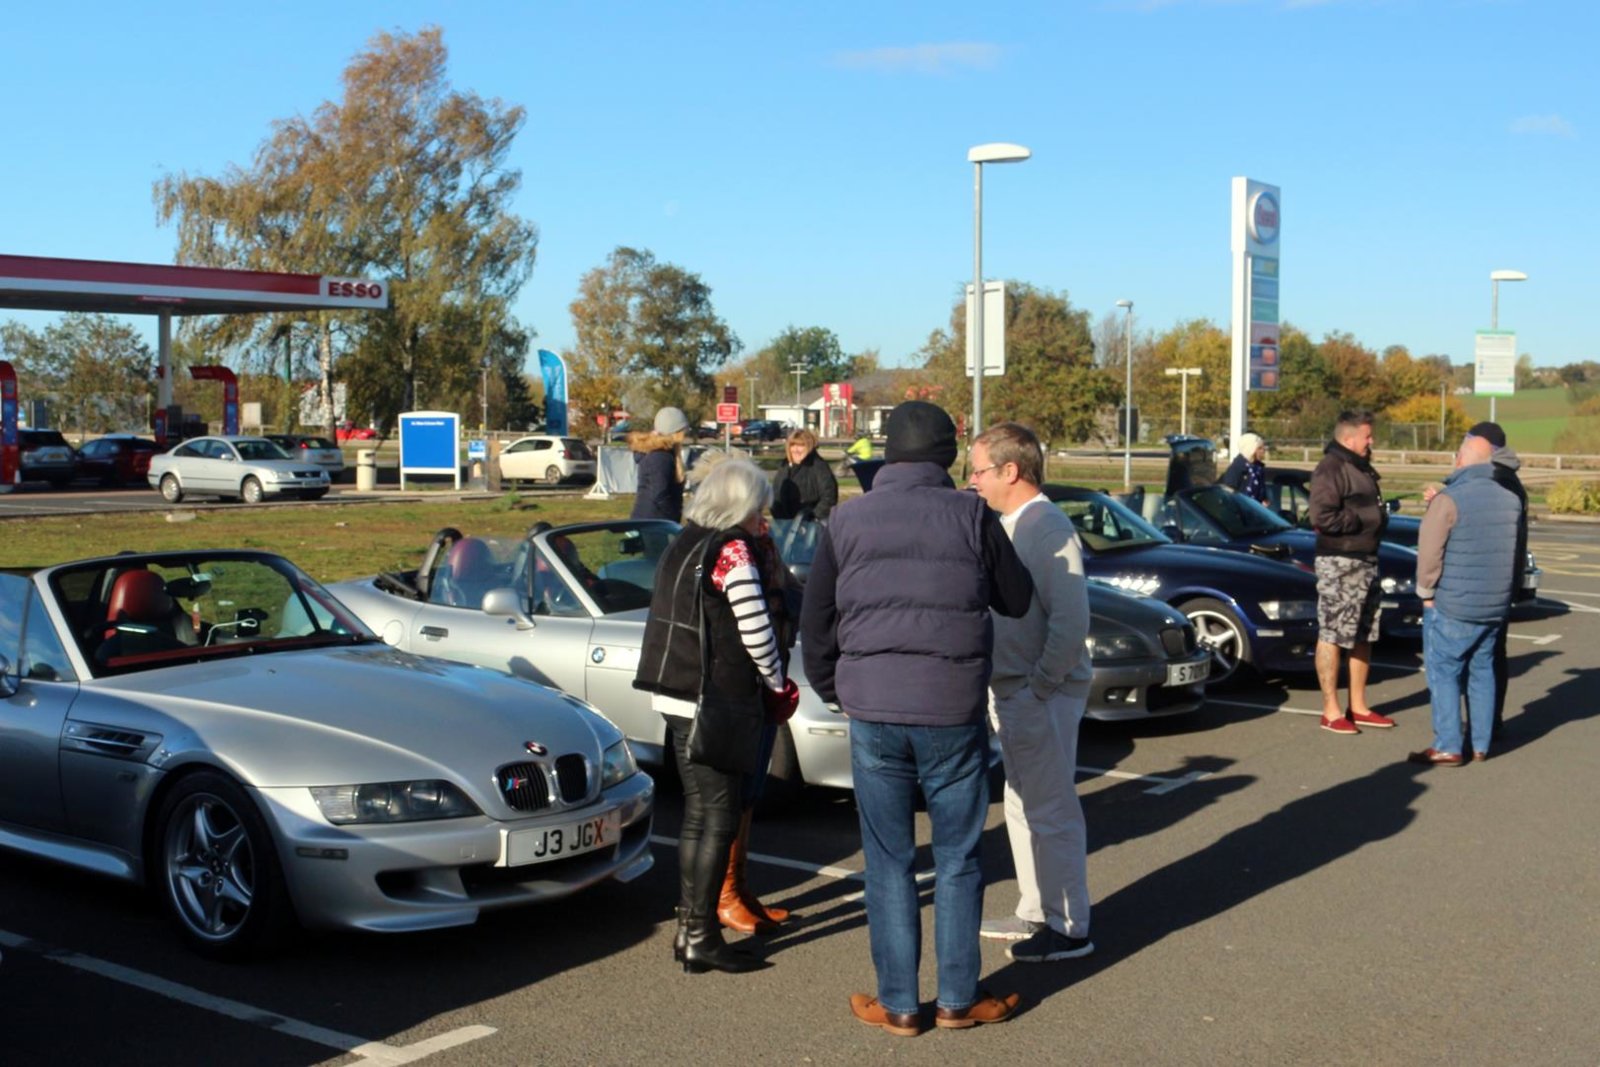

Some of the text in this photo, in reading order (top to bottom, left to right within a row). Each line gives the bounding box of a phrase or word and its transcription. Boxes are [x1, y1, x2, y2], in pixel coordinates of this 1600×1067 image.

[328, 282, 382, 299] ESSO
[534, 819, 604, 857] J3 JGX
